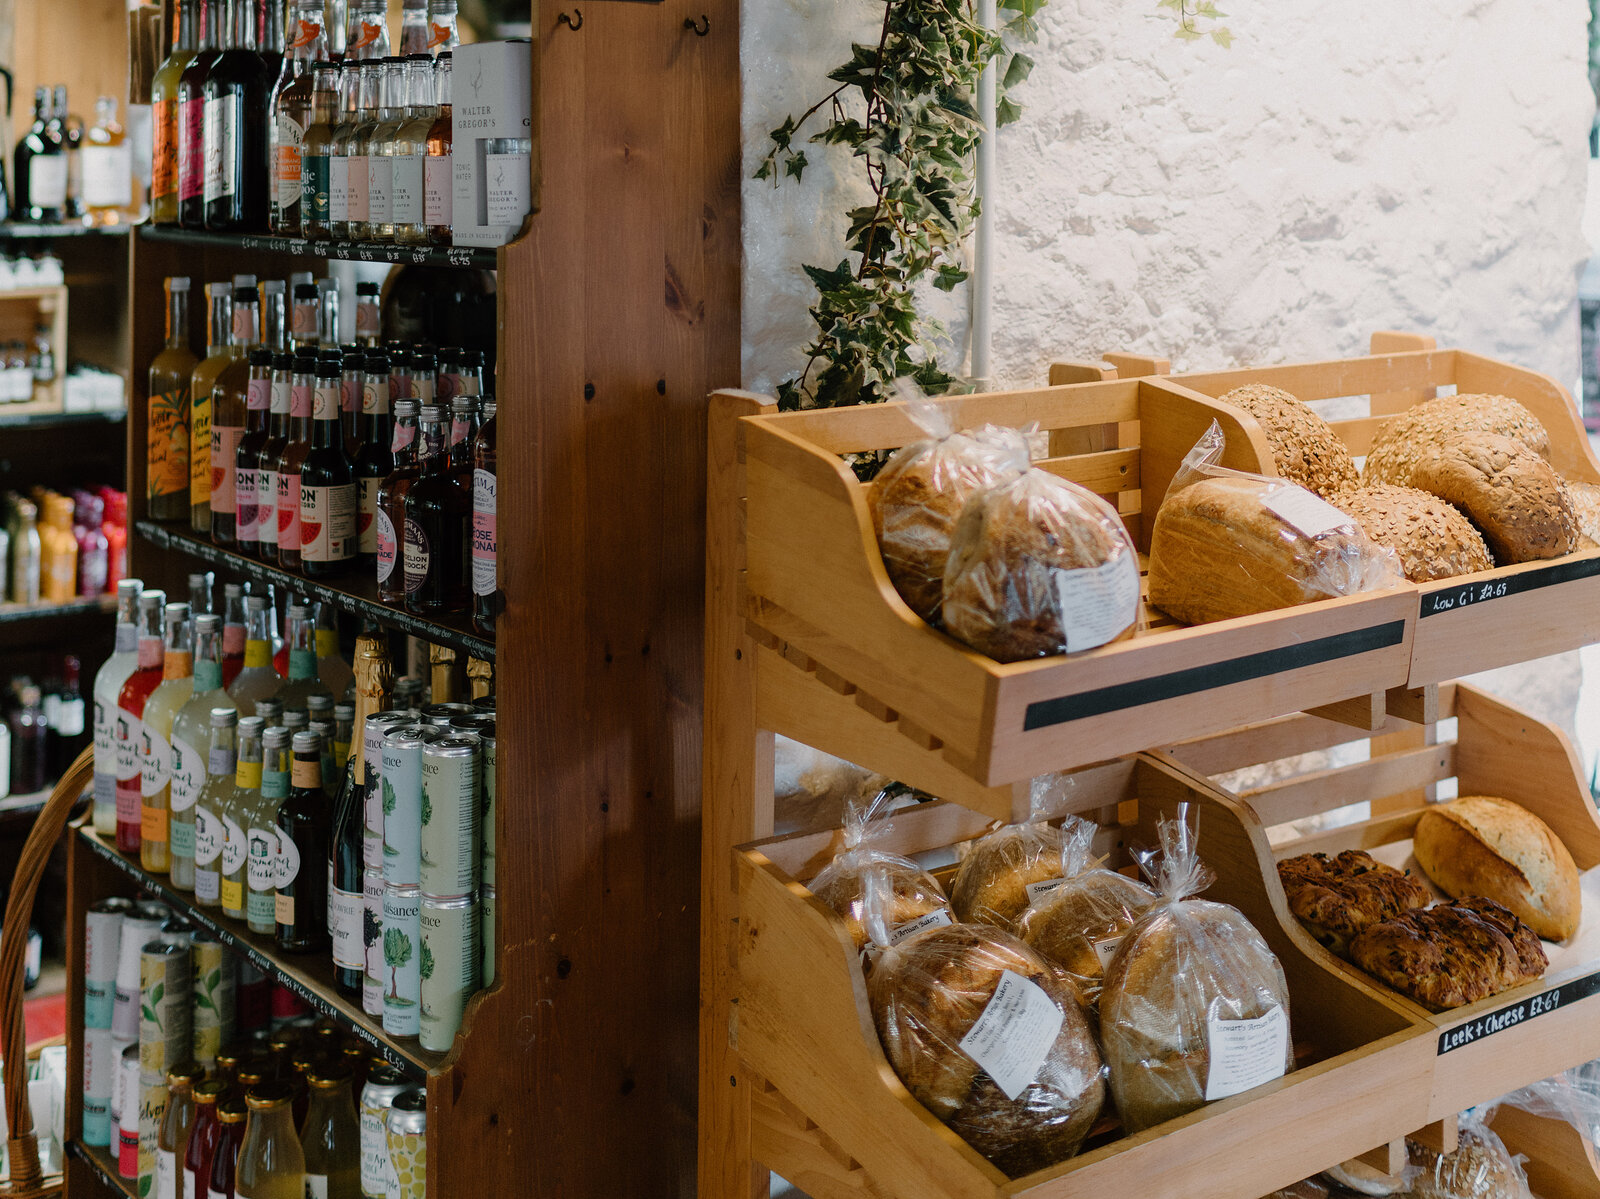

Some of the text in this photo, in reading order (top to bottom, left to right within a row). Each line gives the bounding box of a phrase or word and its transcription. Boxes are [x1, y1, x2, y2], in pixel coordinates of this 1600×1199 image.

[462, 105, 492, 116] WALTER
[458, 118, 496, 129] GREGOR'S
[456, 172, 472, 181] WATER
[1433, 596, 1454, 610] Low
[1479, 582, 1507, 600] £2.69
[918, 914, 940, 928] Bakery
[995, 979, 1013, 1002] Bakery
[1529, 989, 1560, 1017] £2.69
